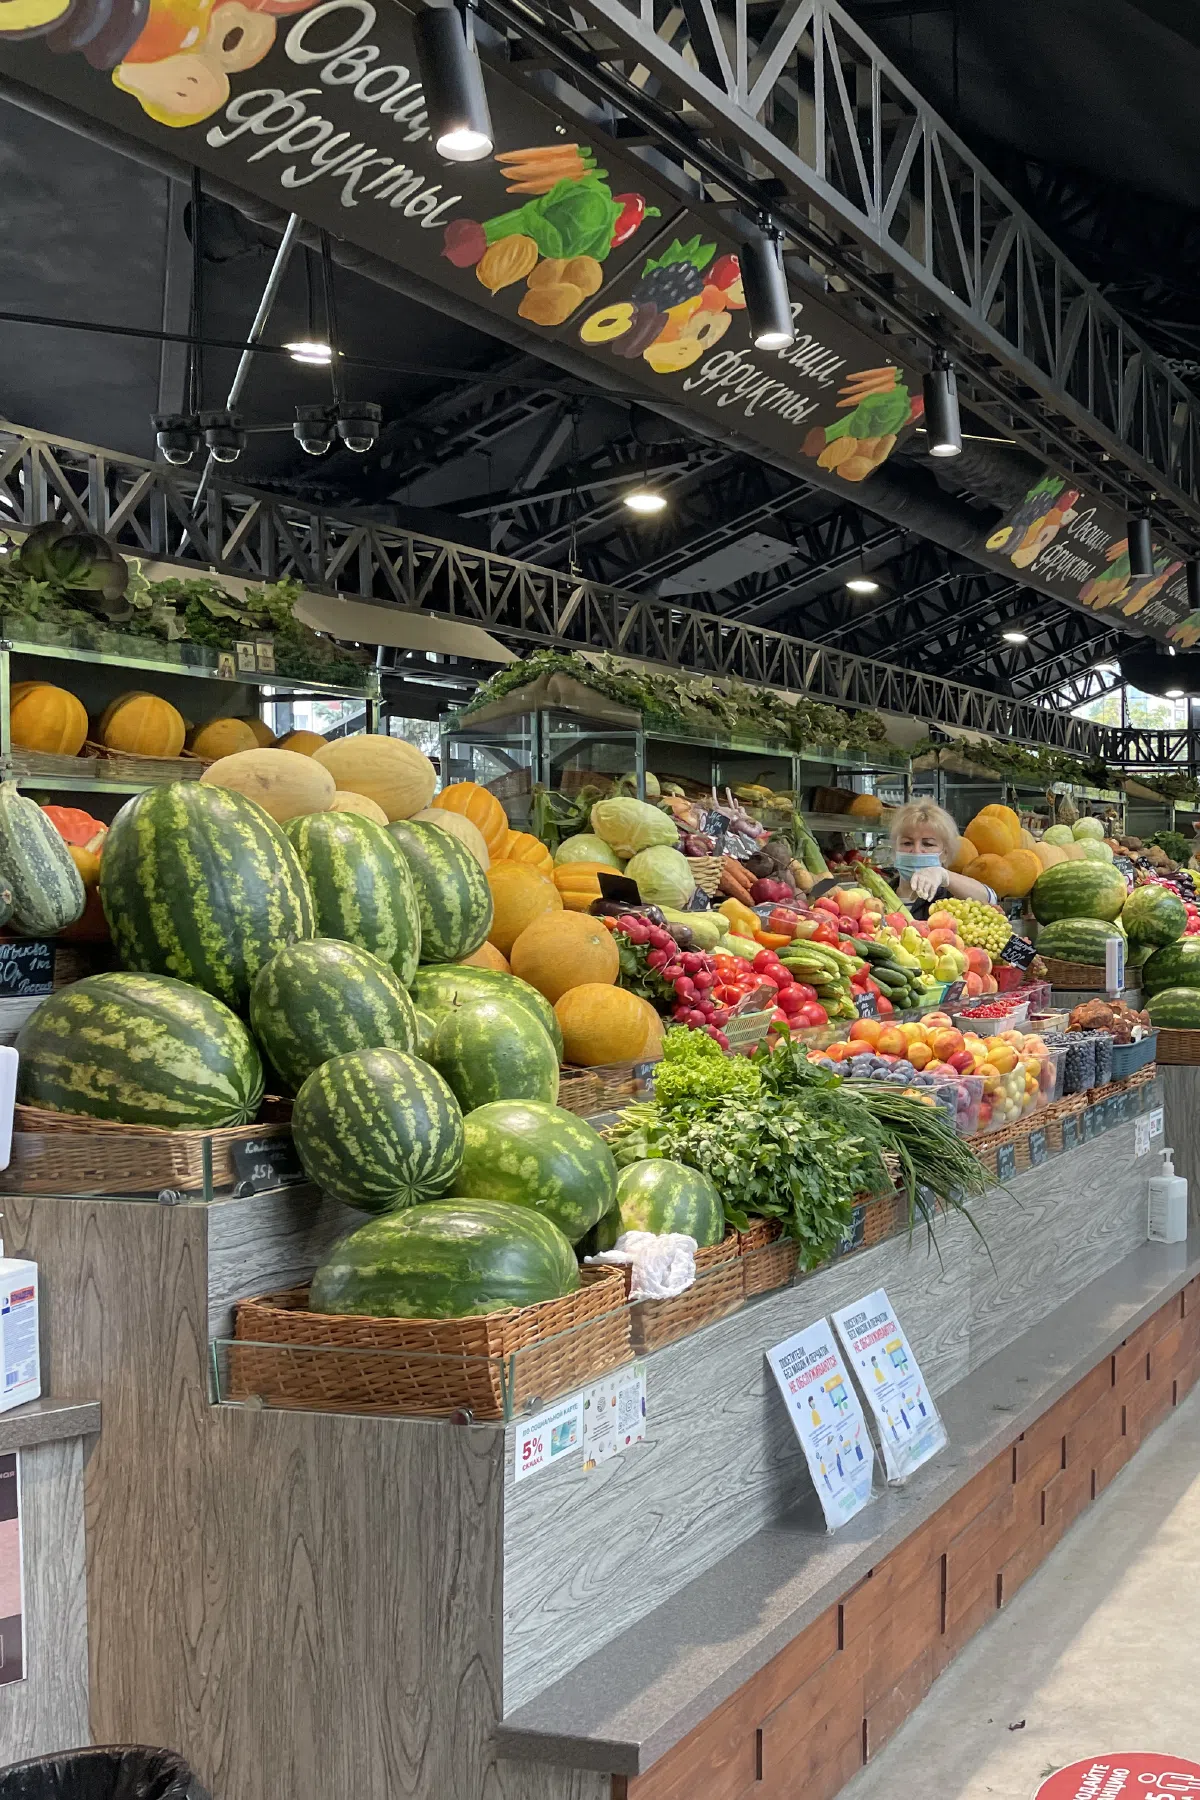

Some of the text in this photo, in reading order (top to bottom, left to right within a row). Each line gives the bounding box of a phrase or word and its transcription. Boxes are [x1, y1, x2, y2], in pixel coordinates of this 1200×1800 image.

[285, 0, 433, 142] Овощ
[522, 1434, 543, 1461] 5%
[522, 1456, 544, 1471] СКИДКА
[1072, 1763, 1110, 1800] ЮДАЙТЕ
